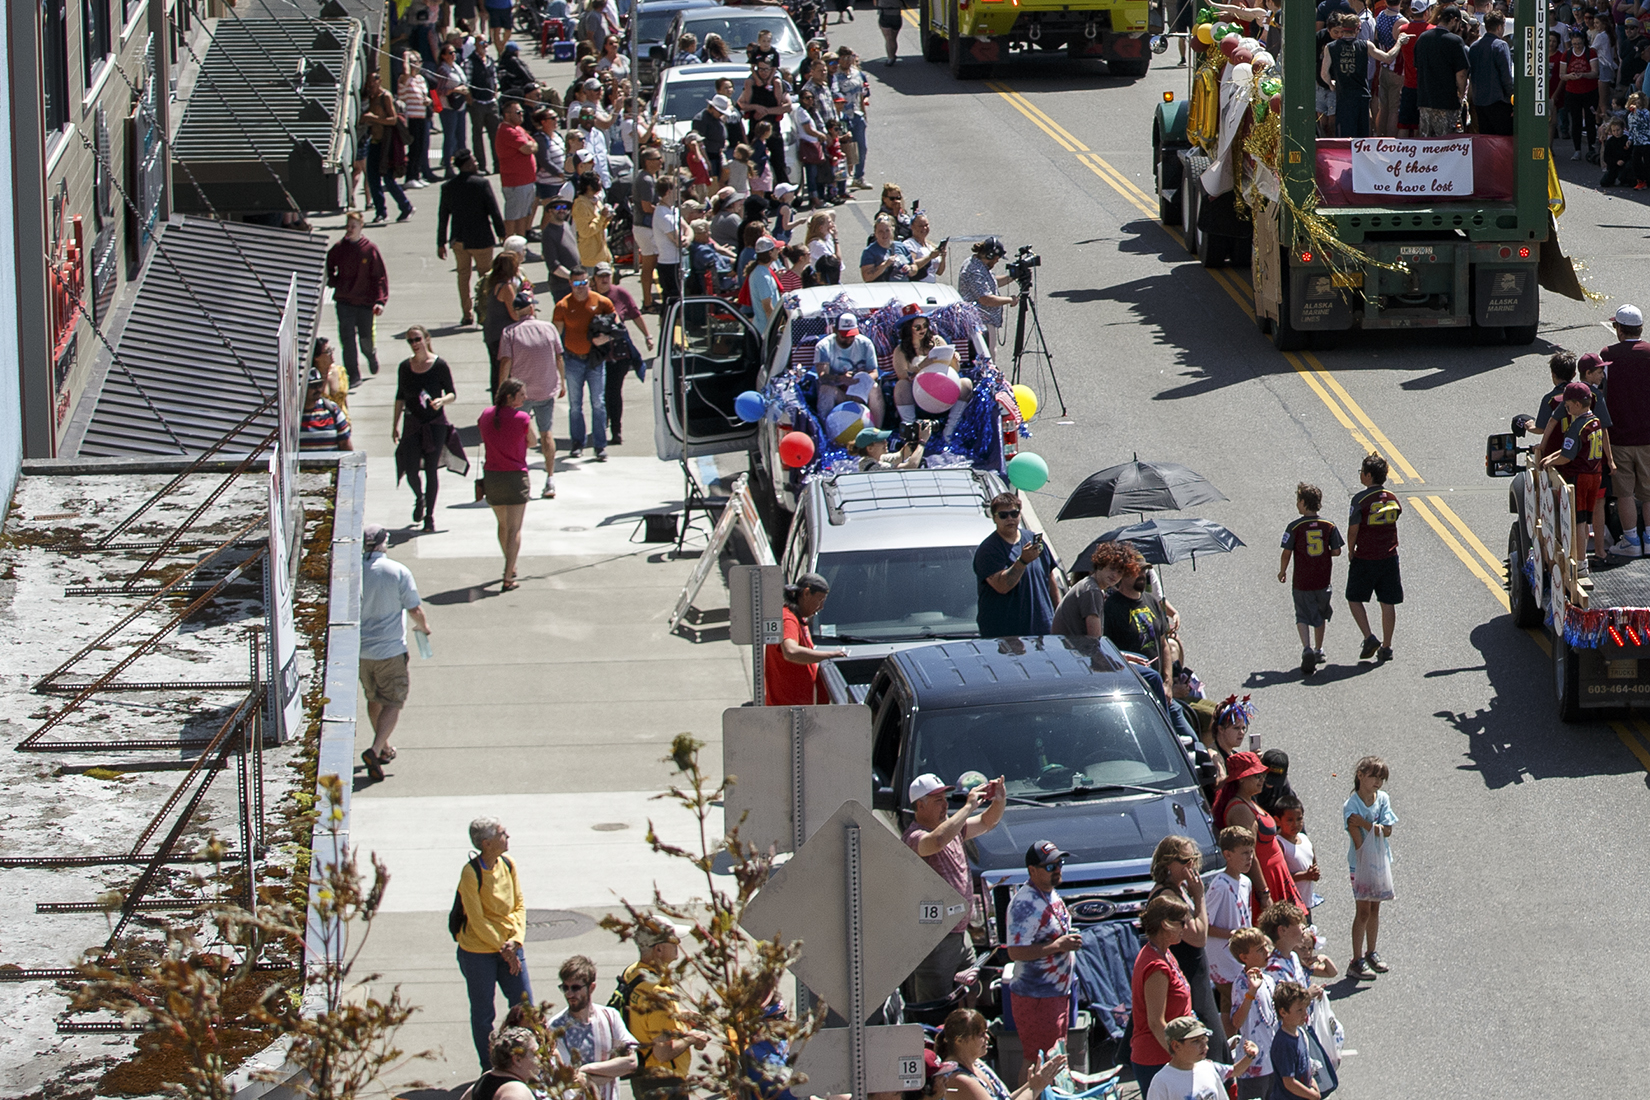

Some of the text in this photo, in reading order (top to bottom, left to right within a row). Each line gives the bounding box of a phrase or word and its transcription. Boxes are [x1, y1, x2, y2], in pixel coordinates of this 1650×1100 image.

[1526, 27, 1534, 76] BNP2
[1340, 63, 1356, 73] US
[1537, 27, 1545, 100] 248621
[1537, 103, 1544, 115] 0
[1354, 139, 1470, 158] In loving memory
[1387, 160, 1438, 177] of those
[1374, 179, 1453, 192] we have lost
[1306, 529, 1324, 557] 5
[766, 622, 778, 632] 18
[924, 906, 938, 919] 18
[1083, 904, 1103, 913] Ford
[903, 1061, 917, 1073] 18
